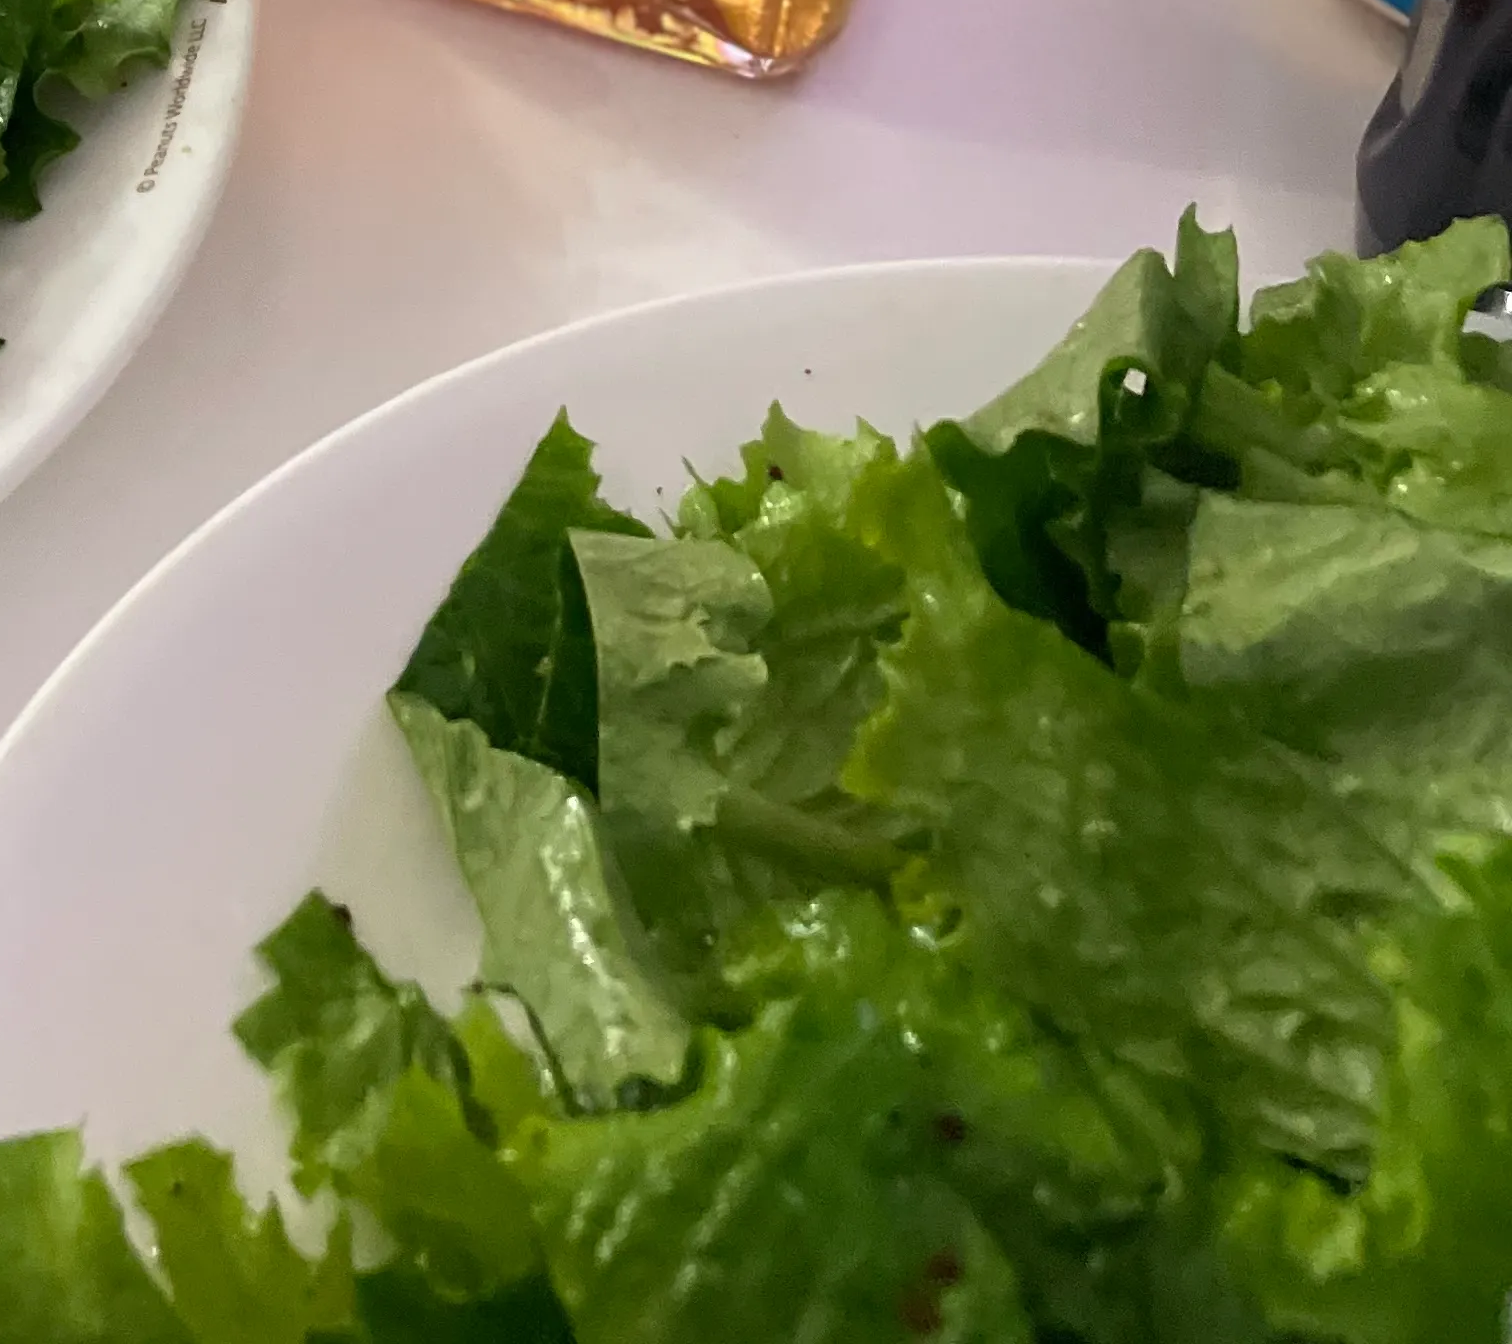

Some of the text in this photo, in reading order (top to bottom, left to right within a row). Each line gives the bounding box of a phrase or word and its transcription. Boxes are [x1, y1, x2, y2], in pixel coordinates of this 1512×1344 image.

[143, 120, 178, 178] Peanuts
[164, 41, 200, 121] Worldwide
[190, 17, 208, 43] LLC
